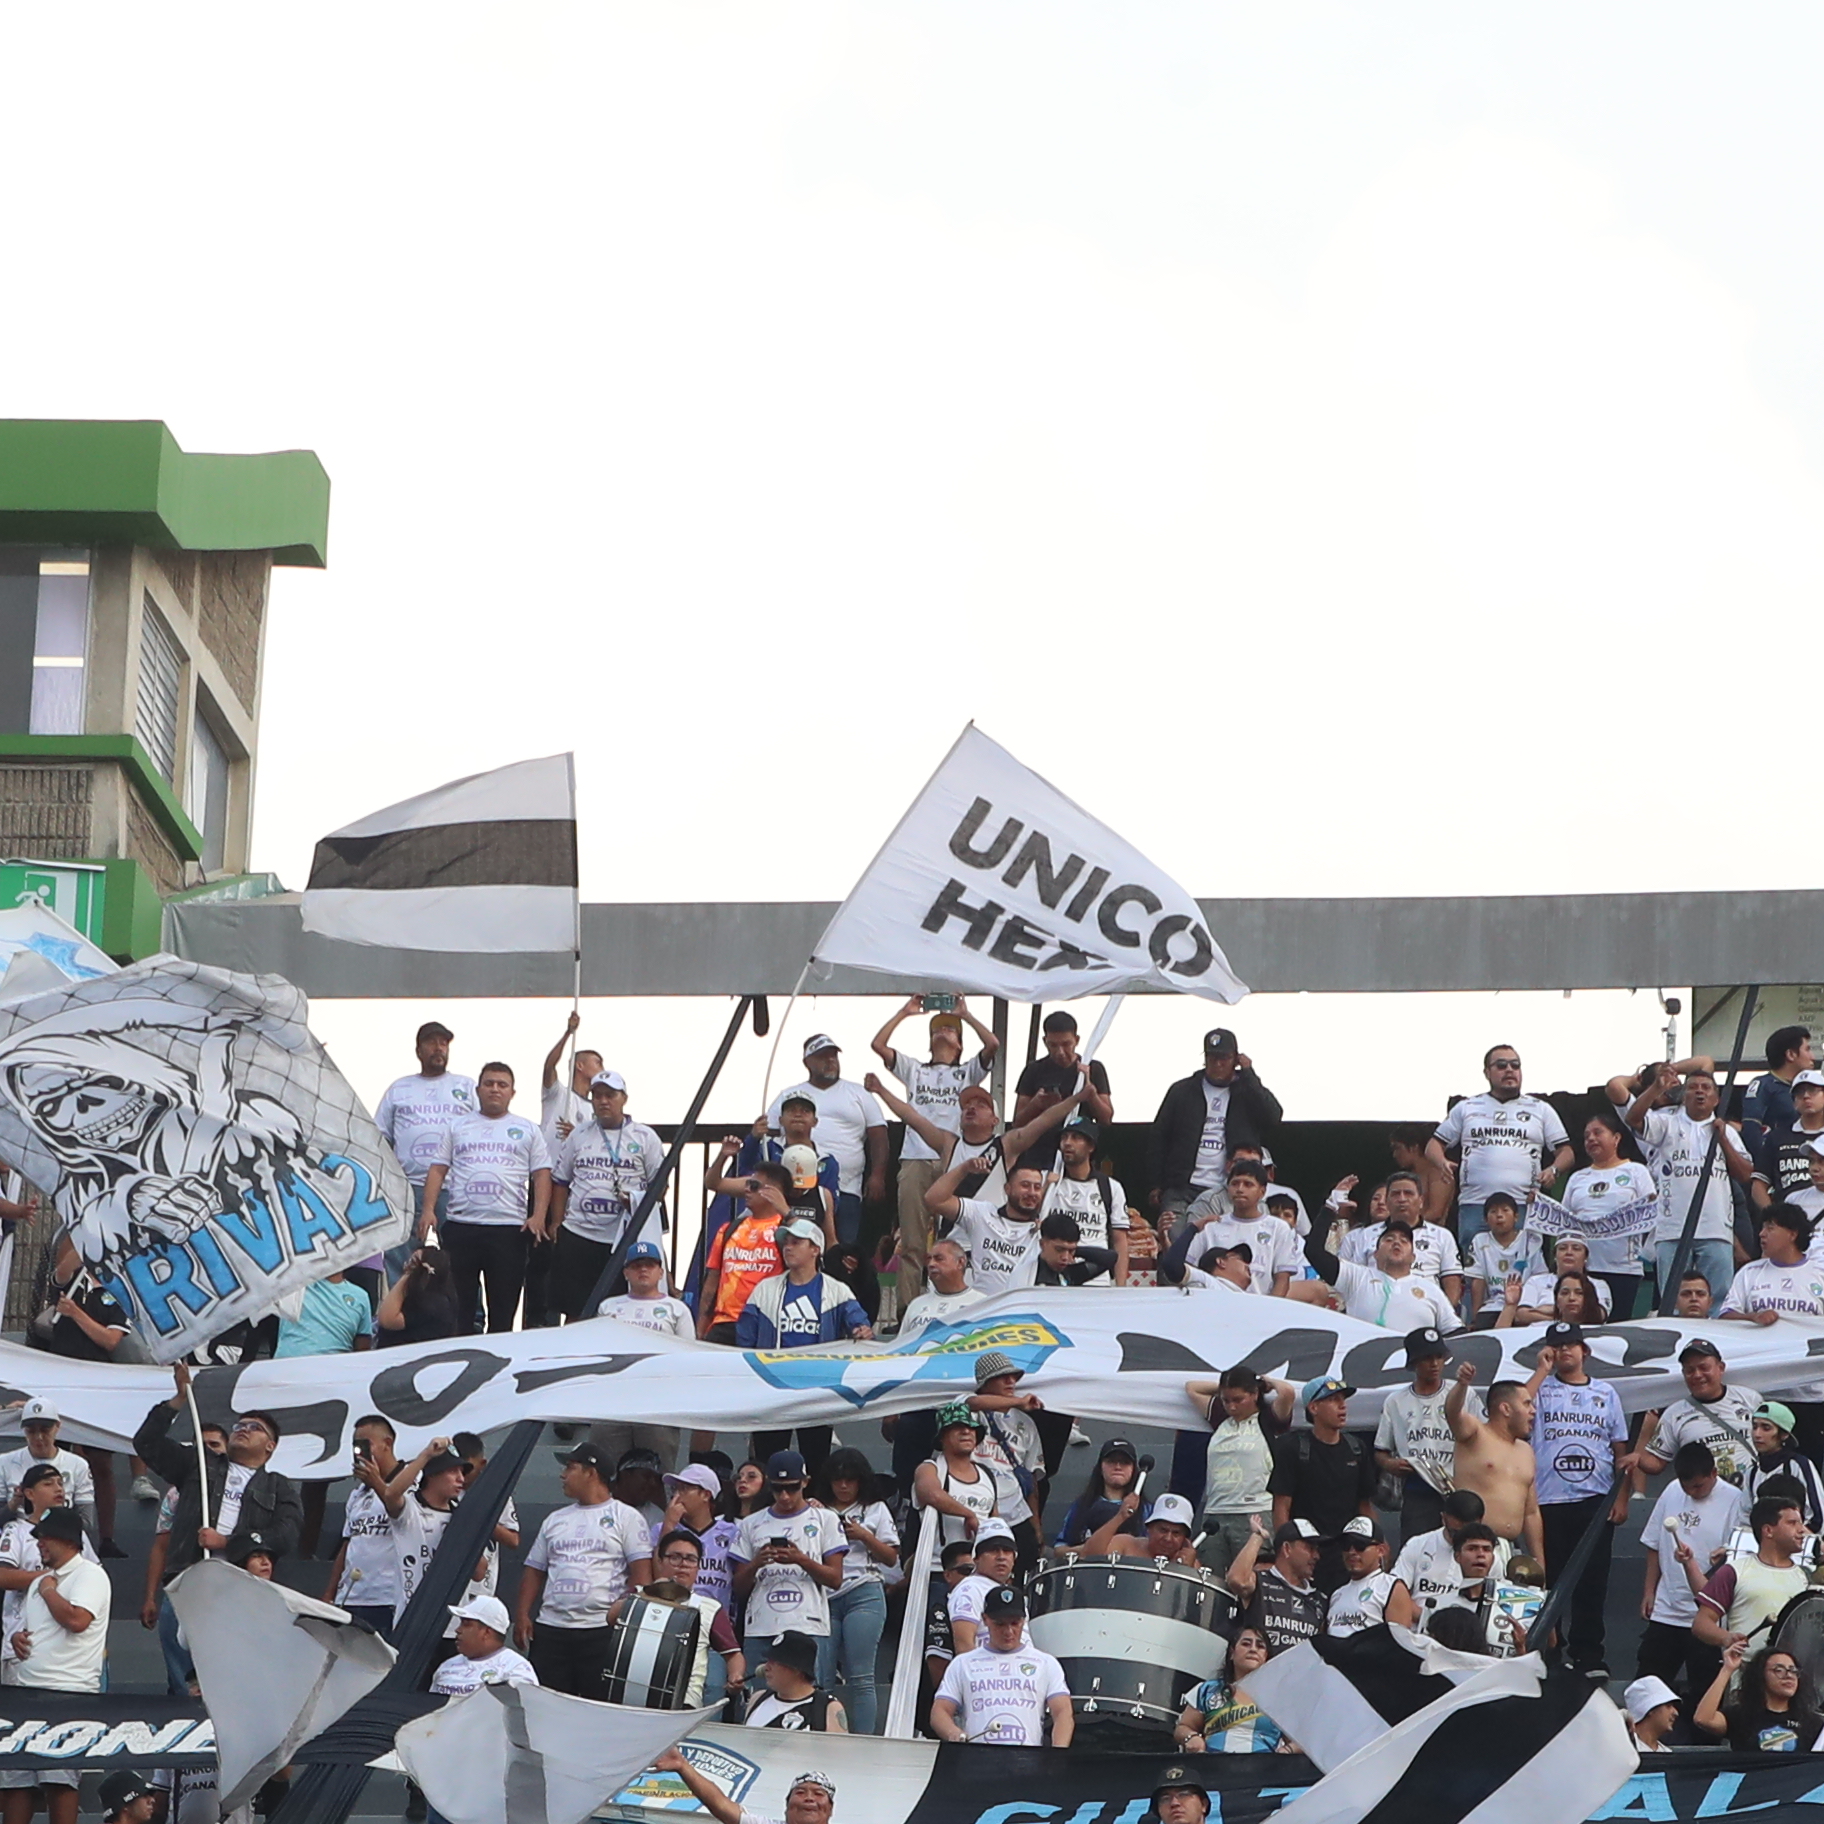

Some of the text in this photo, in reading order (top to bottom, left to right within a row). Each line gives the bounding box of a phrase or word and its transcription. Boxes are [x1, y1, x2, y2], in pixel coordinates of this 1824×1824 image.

[949, 796, 1212, 976] UNICO
[1471, 1127, 1527, 1140] BANRURAL
[410, 1143, 438, 1158] Gul
[454, 1141, 518, 1155] BANRURAL
[575, 1156, 637, 1171] BANRURAL
[1778, 1158, 1810, 1173] BANR
[465, 1180, 498, 1195] Gulf
[983, 1237, 1026, 1256] BANRUR
[722, 1247, 777, 1262] BANRURAL
[1751, 1296, 1819, 1315] BANRURAL
[778, 1316, 821, 1335] adidas
[1544, 1411, 1607, 1427] BANRURAL
[1695, 1430, 1751, 1445] ANRURAL
[1555, 1454, 1595, 1473] Gulf
[1419, 1577, 1459, 1594] Bantr
[767, 1589, 803, 1605] Gulf
[434, 1682, 475, 1695] BANRUR
[970, 1678, 1037, 1695] BANRURAL
